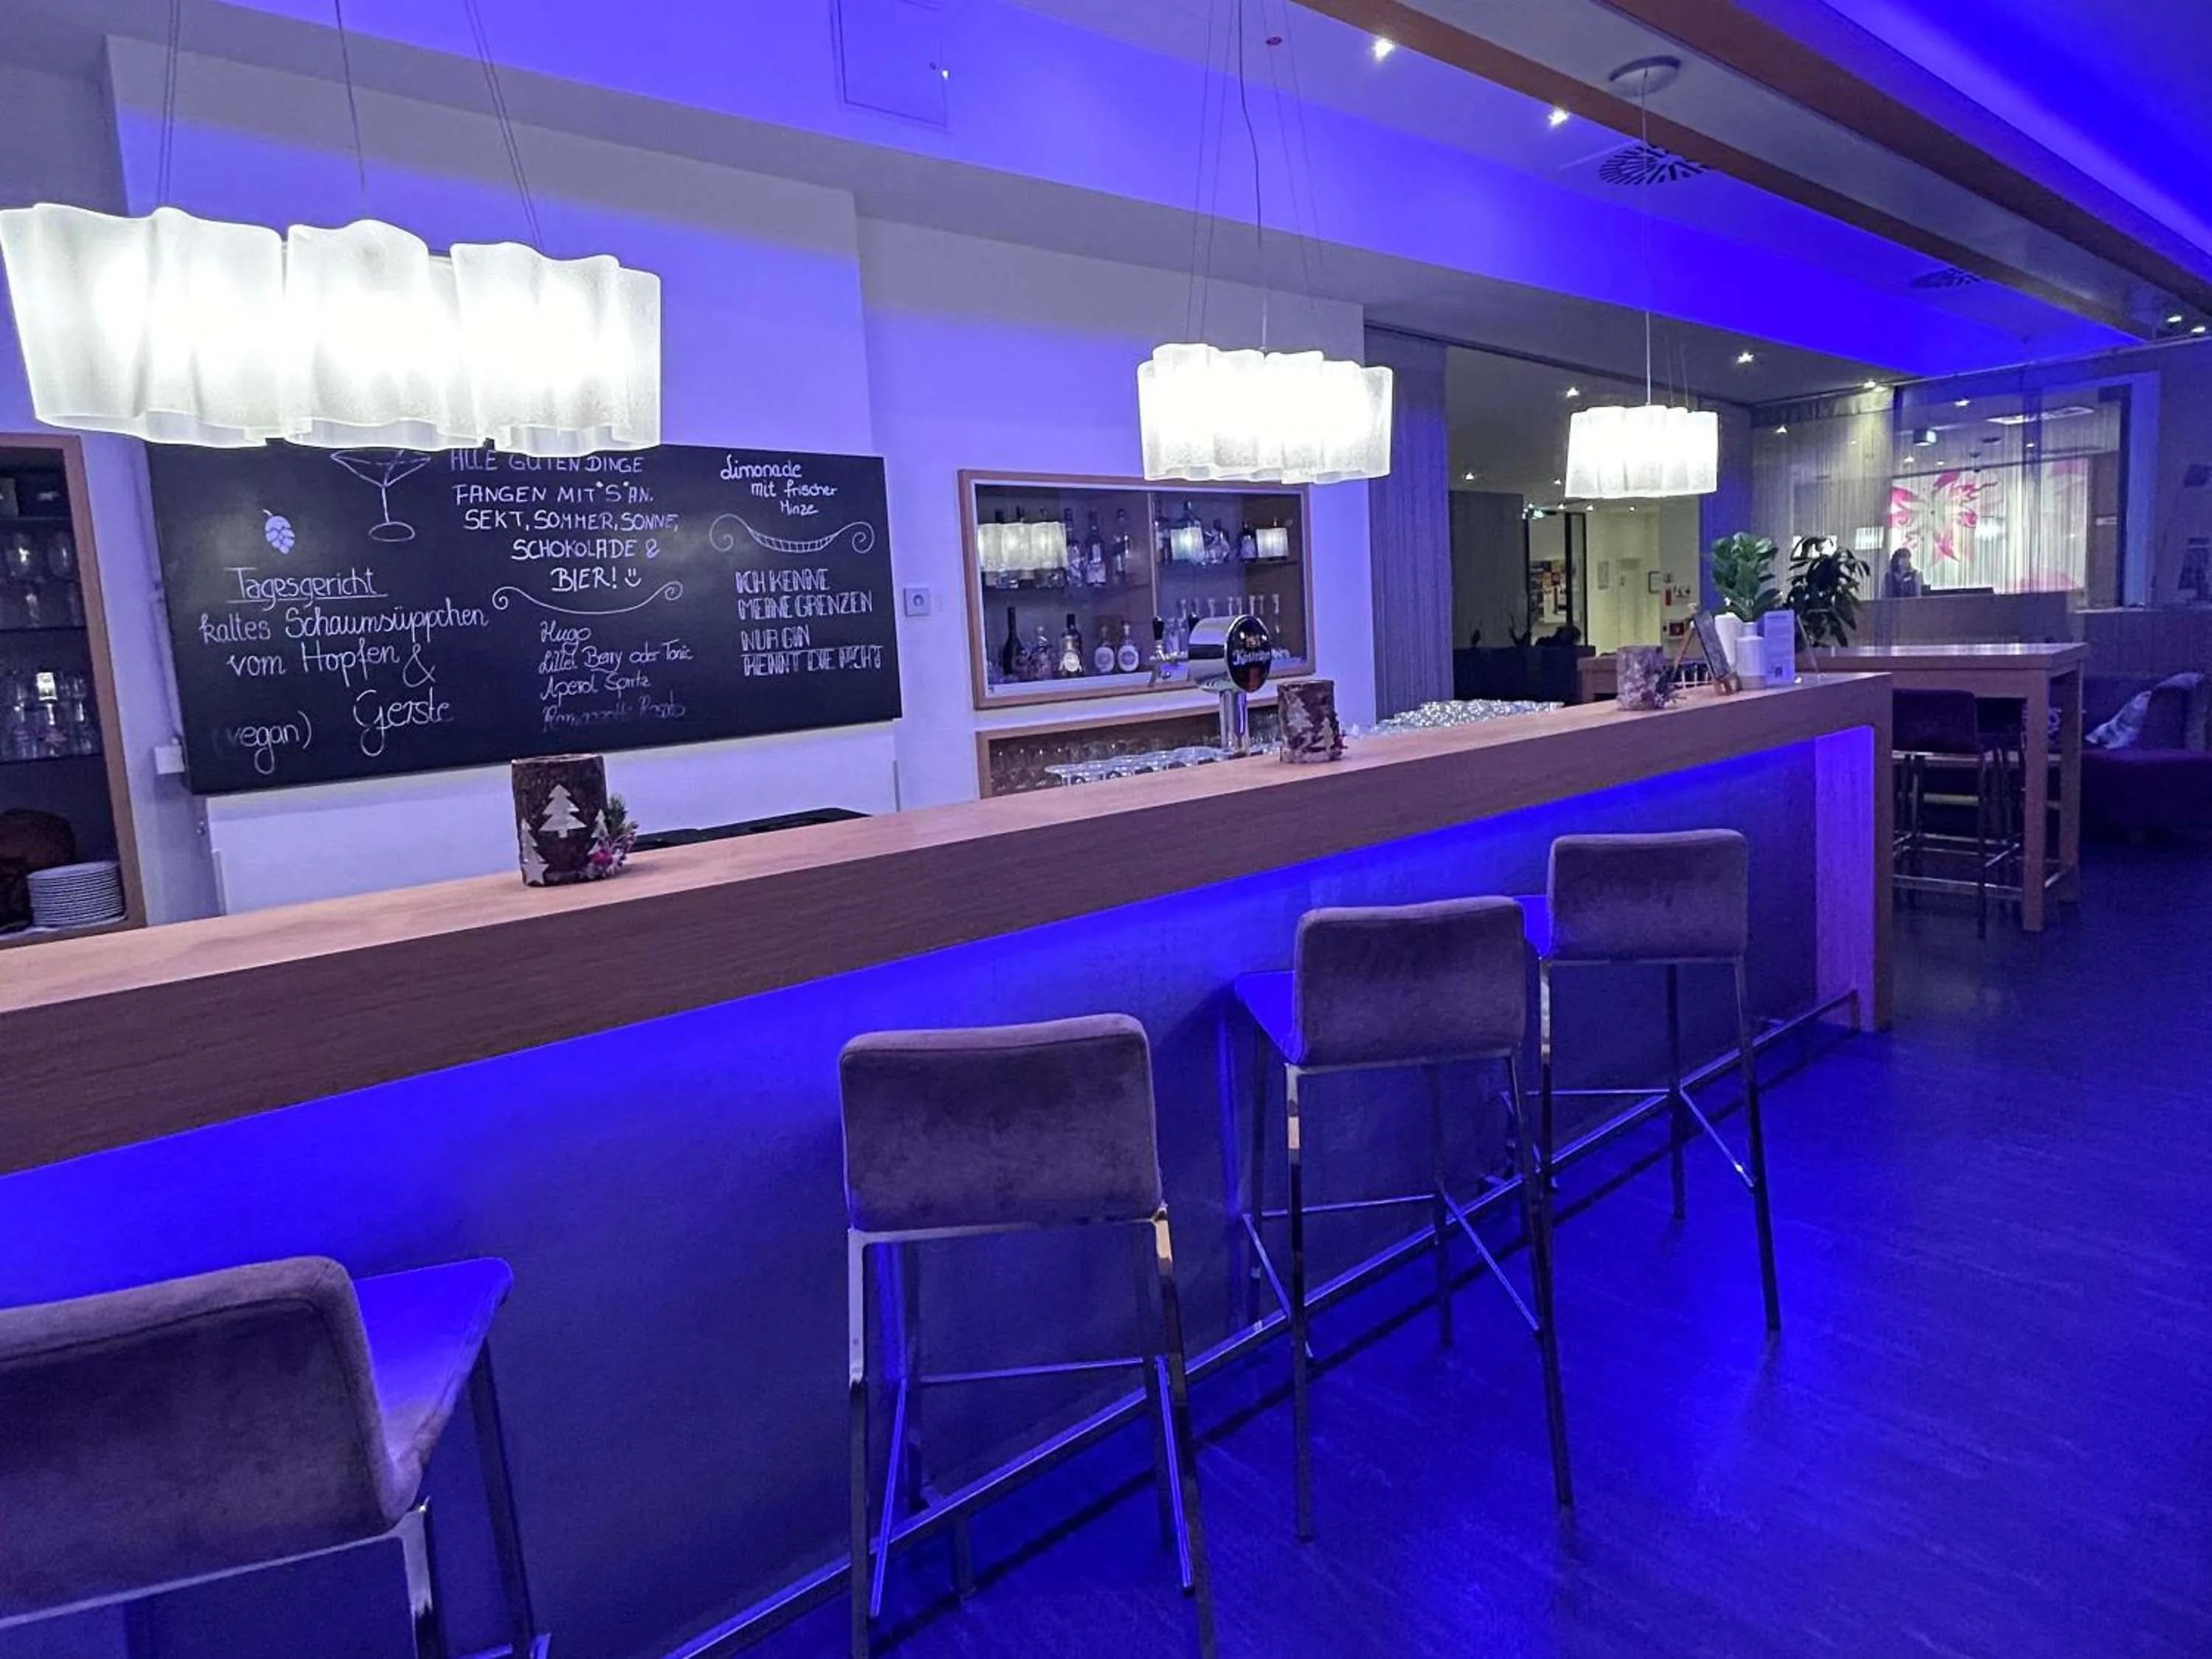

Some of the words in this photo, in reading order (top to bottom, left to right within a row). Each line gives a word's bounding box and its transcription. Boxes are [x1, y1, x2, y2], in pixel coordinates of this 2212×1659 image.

[585, 456, 645, 473] DINGE
[720, 453, 803, 480] Limonade
[452, 484, 547, 506] FANGEN
[557, 487, 596, 503] MIT
[751, 481, 777, 498] mit
[784, 479, 838, 497] frischer
[463, 509, 530, 531] SEKT,
[533, 509, 619, 531] SOMMER,
[779, 500, 819, 516] Minze
[511, 539, 638, 560] SCHOKOLADE
[223, 567, 378, 611] Tagesgericht
[550, 567, 619, 592] BIER!
[736, 569, 766, 594] ICH
[769, 568, 831, 592] KENNE
[737, 595, 793, 620] MEINE
[794, 591, 873, 619] GRENZEN
[199, 613, 271, 644] kaltes
[285, 597, 490, 644] Schaumsüppchen
[540, 620, 592, 655] Hugo
[740, 628, 779, 652] NUR
[226, 653, 286, 677] vom
[302, 638, 400, 687] Hopfen
[402, 642, 437, 688] &
[581, 645, 623, 673] Berry
[540, 672, 599, 706] Aperol
[353, 687, 455, 757] Gerste
